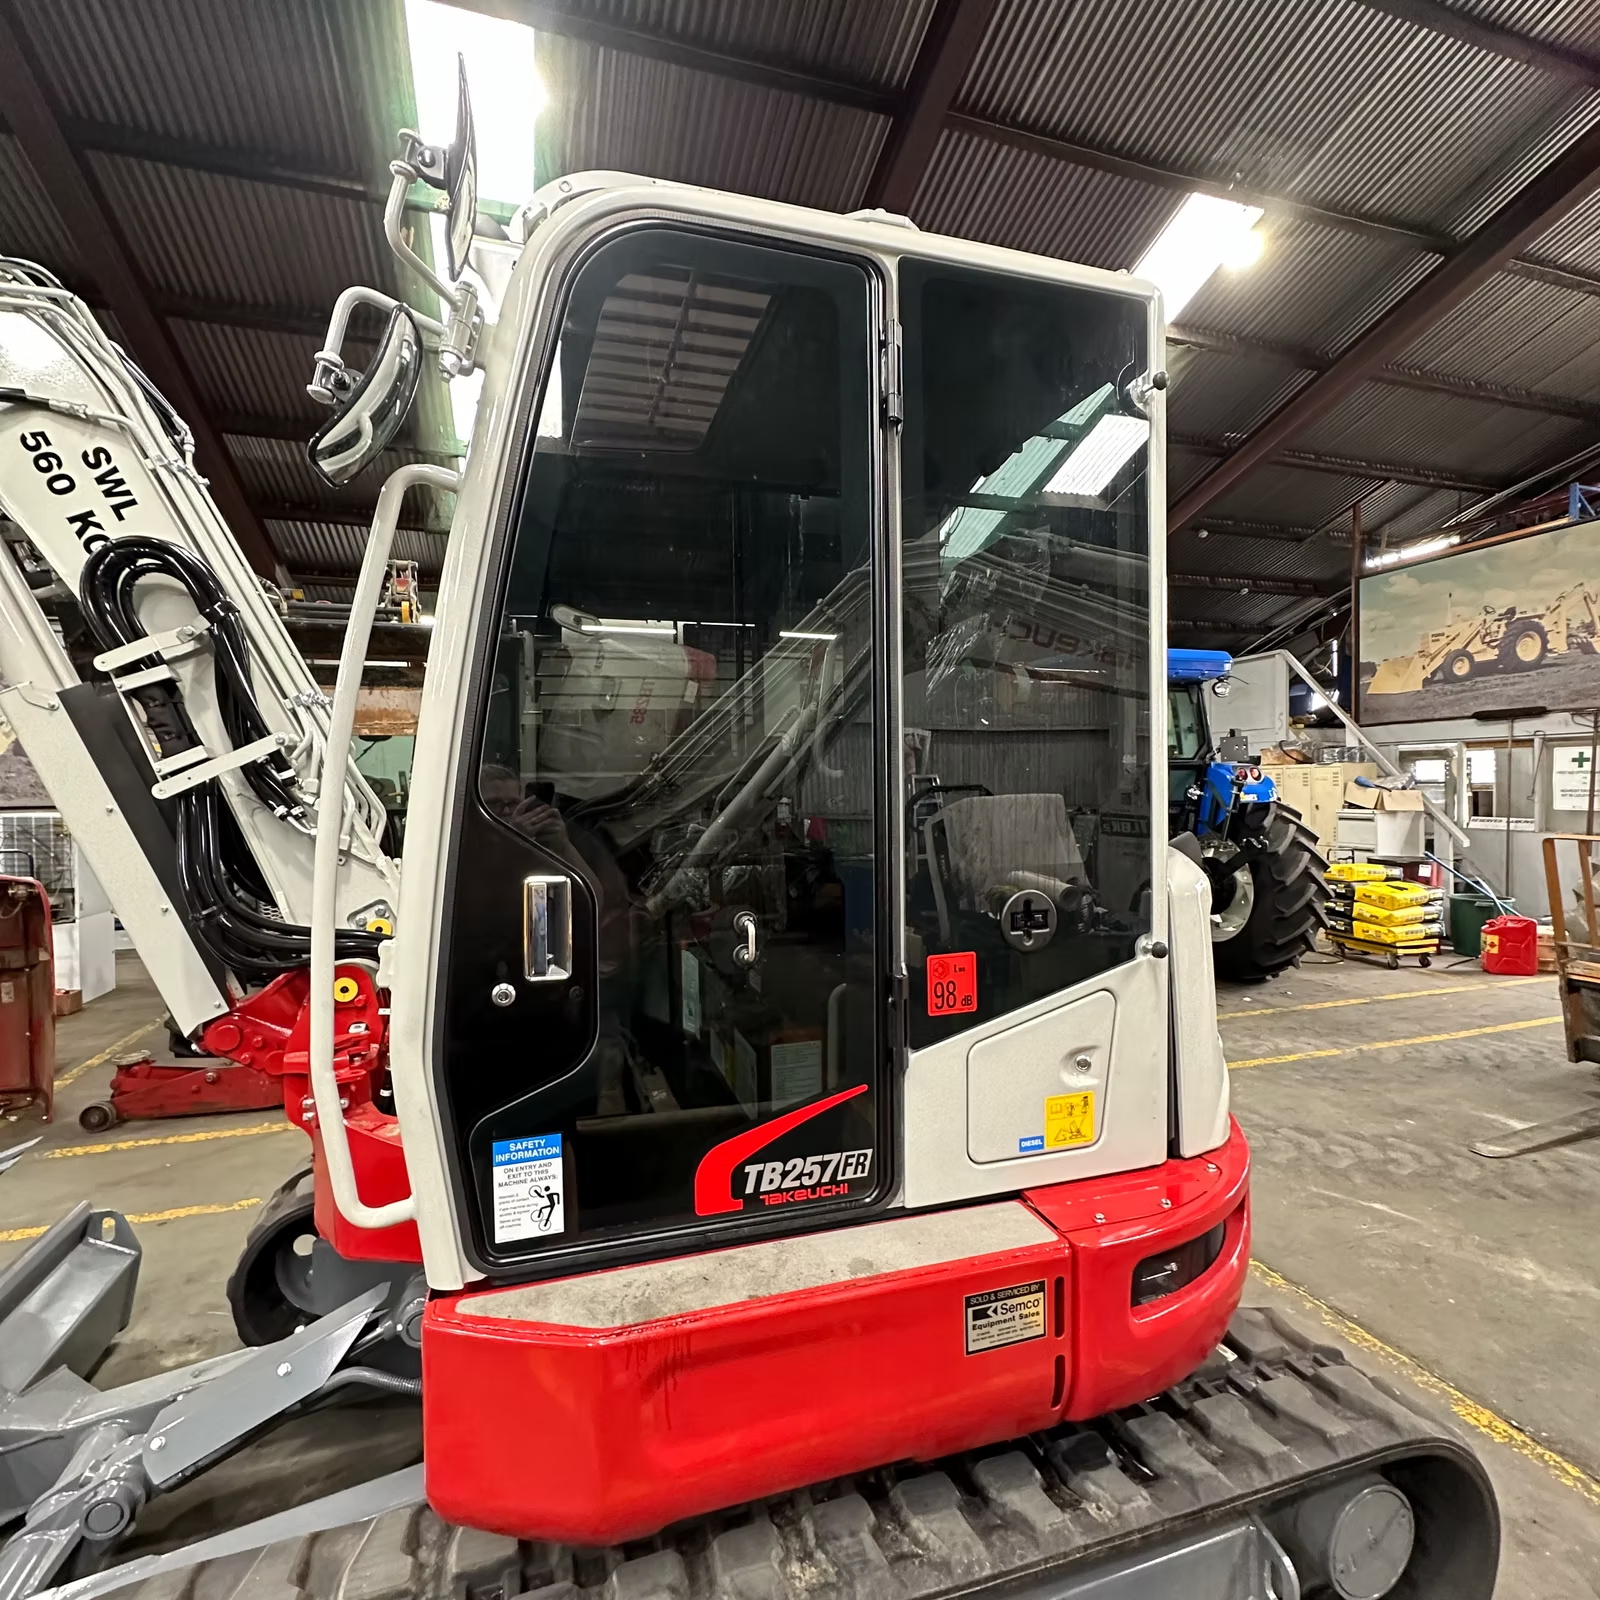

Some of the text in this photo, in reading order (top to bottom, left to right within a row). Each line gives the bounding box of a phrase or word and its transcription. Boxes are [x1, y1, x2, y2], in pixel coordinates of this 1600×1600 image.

[20, 431, 76, 496] 560
[81, 446, 139, 522] SWL
[933, 980, 973, 1010] 98 dB
[508, 1138, 546, 1152] SAFETY
[1021, 1138, 1043, 1148] DIESEL
[495, 1145, 560, 1163] INFORMATION
[507, 1172, 522, 1180] EXIT
[534, 1168, 549, 1176] THIS
[515, 1163, 537, 1173] ENTRY
[538, 1161, 552, 1169] AND
[743, 1148, 874, 1195] TB257FR
[498, 1178, 528, 1188] MACHINE
[970, 1283, 1040, 1305] SOLD & SERVICED BY
[972, 1315, 1016, 1331] Equipment
[1019, 1311, 1040, 1320] Sales
